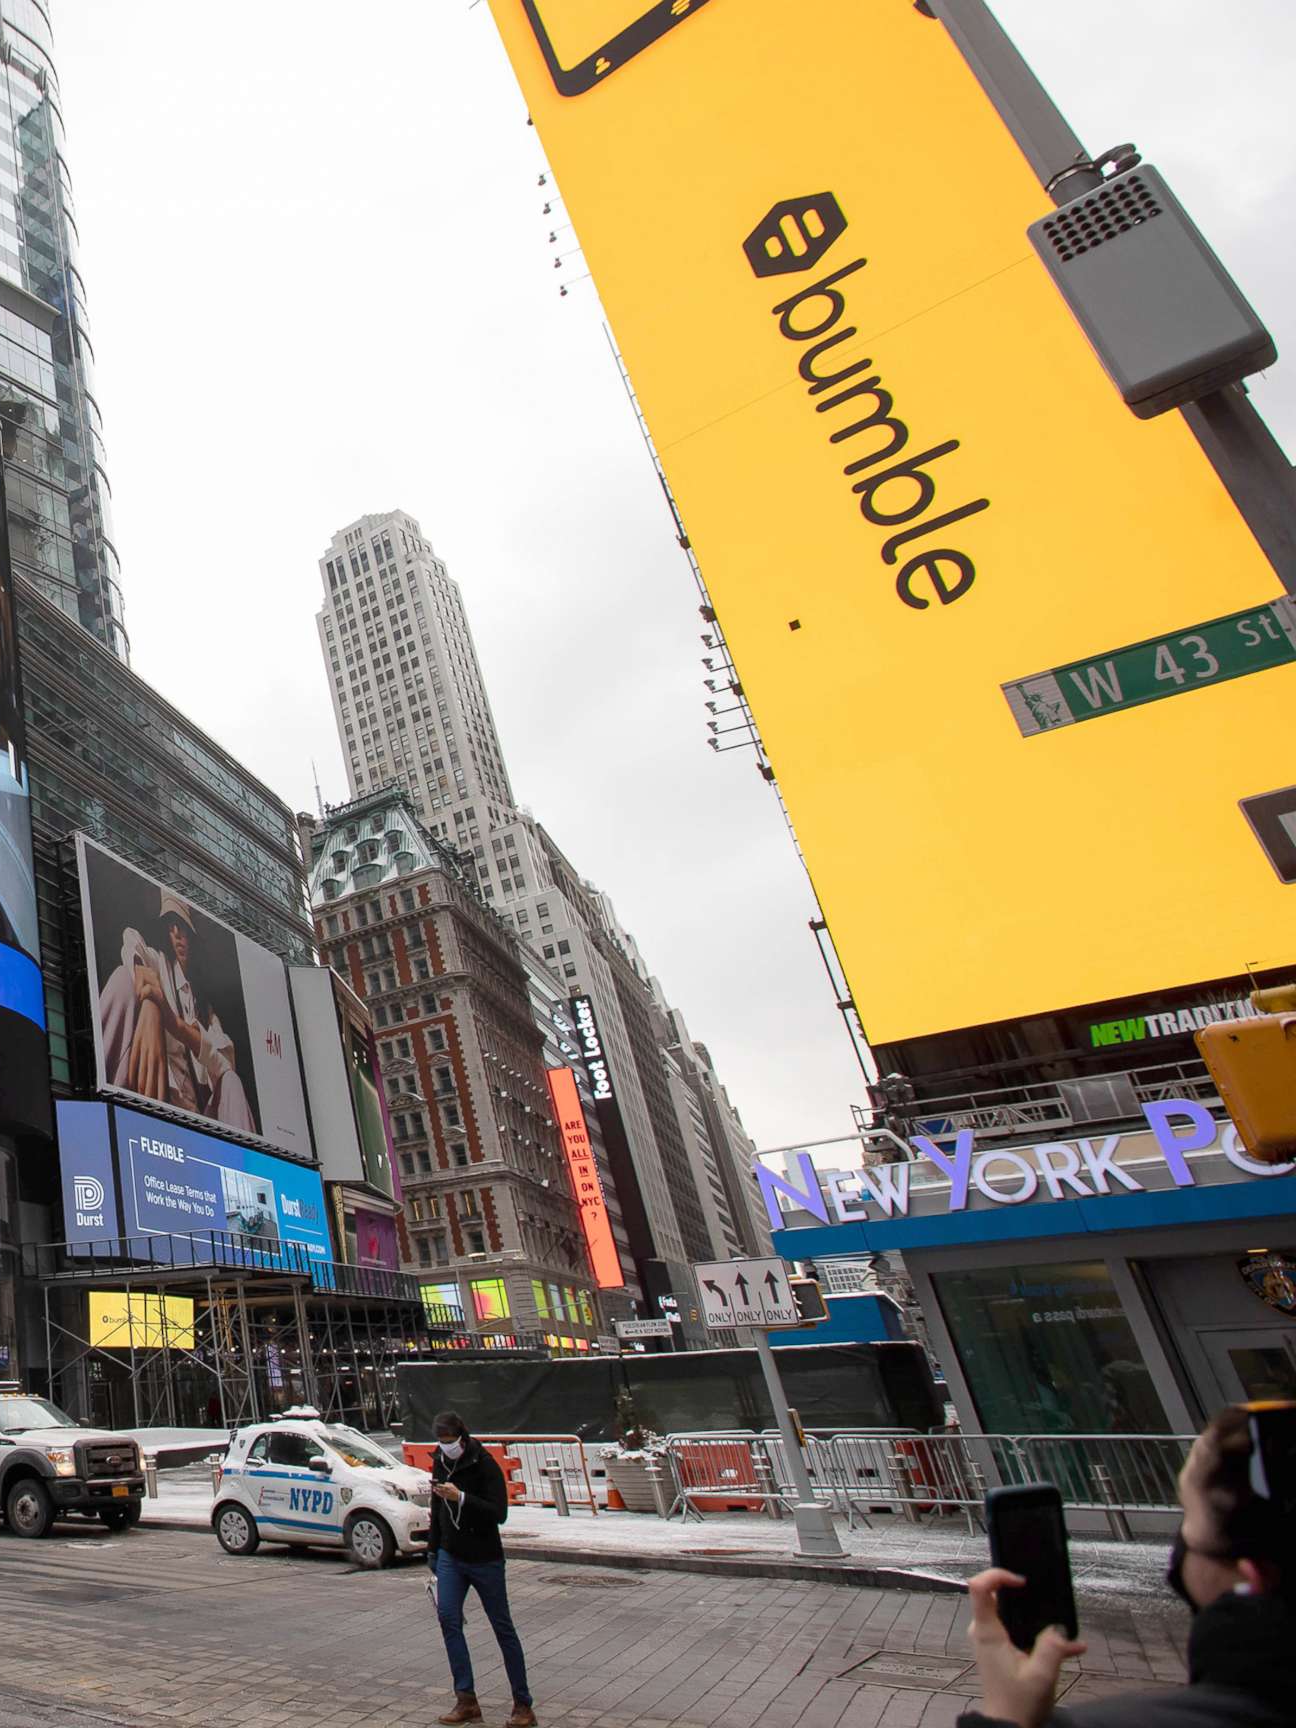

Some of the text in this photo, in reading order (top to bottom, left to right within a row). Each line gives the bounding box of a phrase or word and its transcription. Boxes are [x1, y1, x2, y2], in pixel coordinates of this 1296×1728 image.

[772, 258, 990, 611] bumble
[1069, 614, 1281, 709] W 43 St
[575, 999, 613, 1100] Foot Locker
[565, 1121, 583, 1131] ARE
[567, 1134, 586, 1144] YOU
[141, 1135, 185, 1163] FLEXIBLE
[571, 1148, 590, 1158] ALL
[578, 1165, 589, 1175] IN
[581, 1182, 594, 1192] ON
[754, 1151, 910, 1230] NEW
[911, 1128, 1145, 1211] YORK
[143, 1174, 217, 1203] Office Lease Terms that
[145, 1190, 215, 1217] Work the Way You Do
[581, 1196, 601, 1206] NYC
[76, 1212, 104, 1227] Durst
[591, 1211, 598, 1220] ?
[708, 1308, 793, 1324] ONLY ONLY ONLY
[288, 1487, 334, 1515] NYPD
